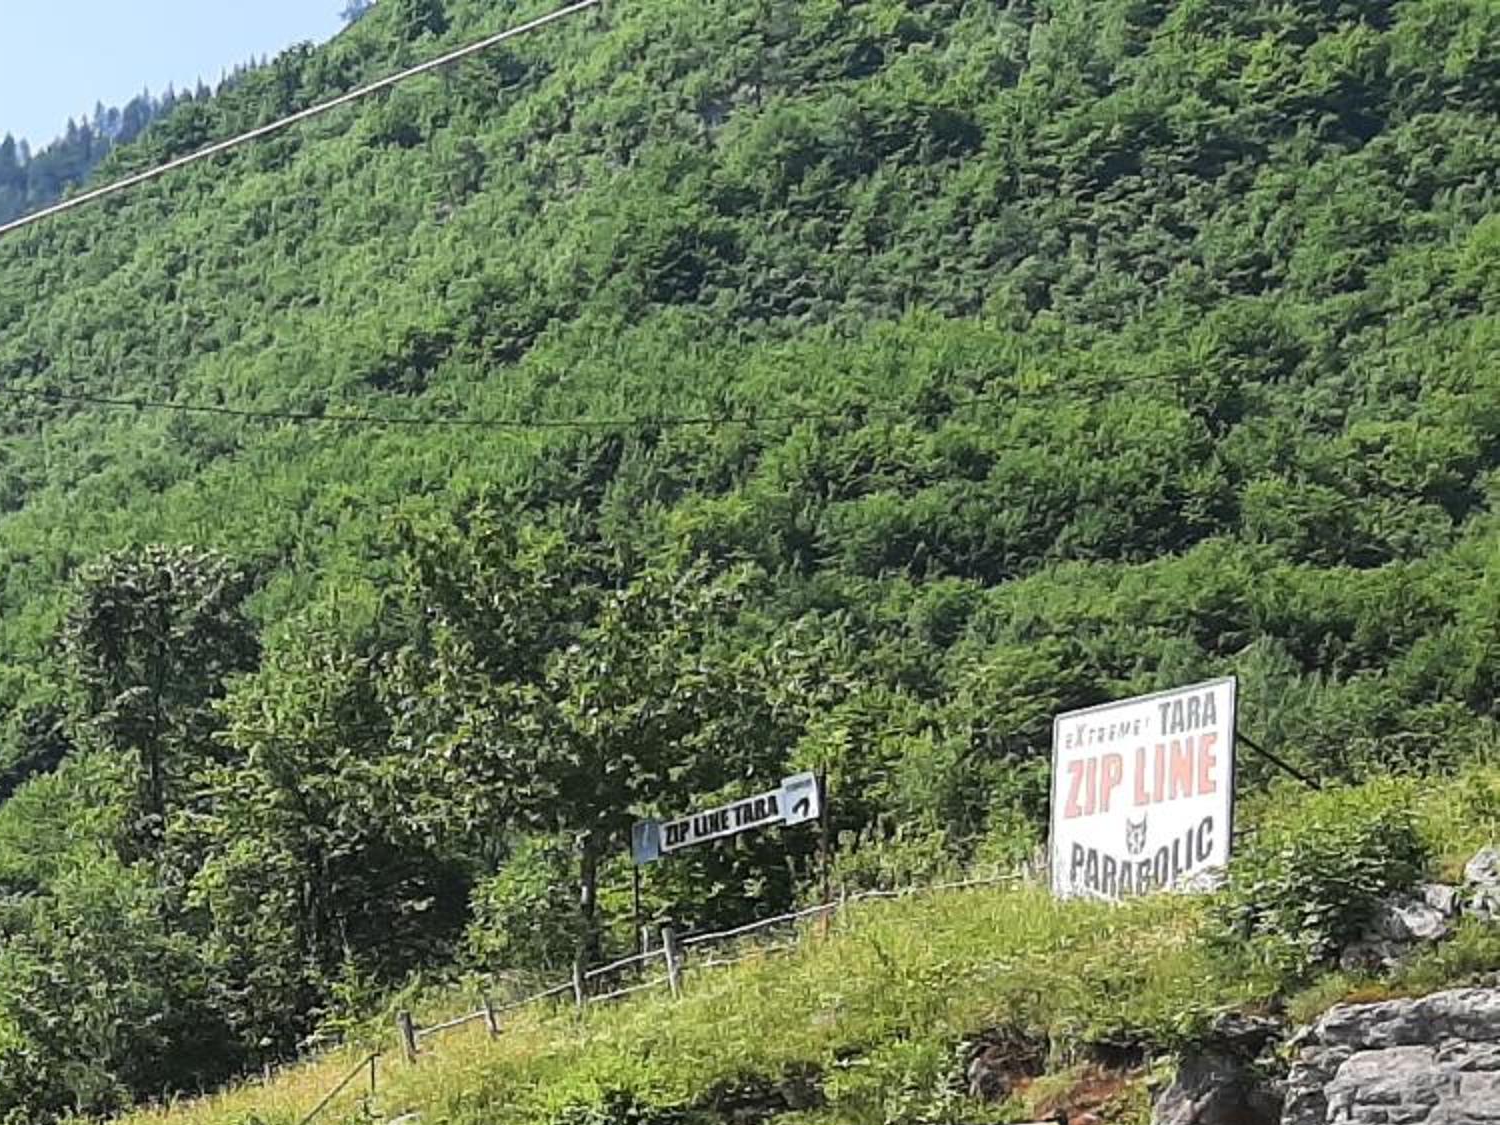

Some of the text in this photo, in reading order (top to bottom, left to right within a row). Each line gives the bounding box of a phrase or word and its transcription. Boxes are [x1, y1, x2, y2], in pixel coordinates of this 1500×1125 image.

[1158, 691, 1217, 736] TARA
[1064, 732, 1217, 819] ZIP LINE
[665, 795, 779, 846] ZIP LINE TARA
[1070, 816, 1213, 899] PARABOLIC
